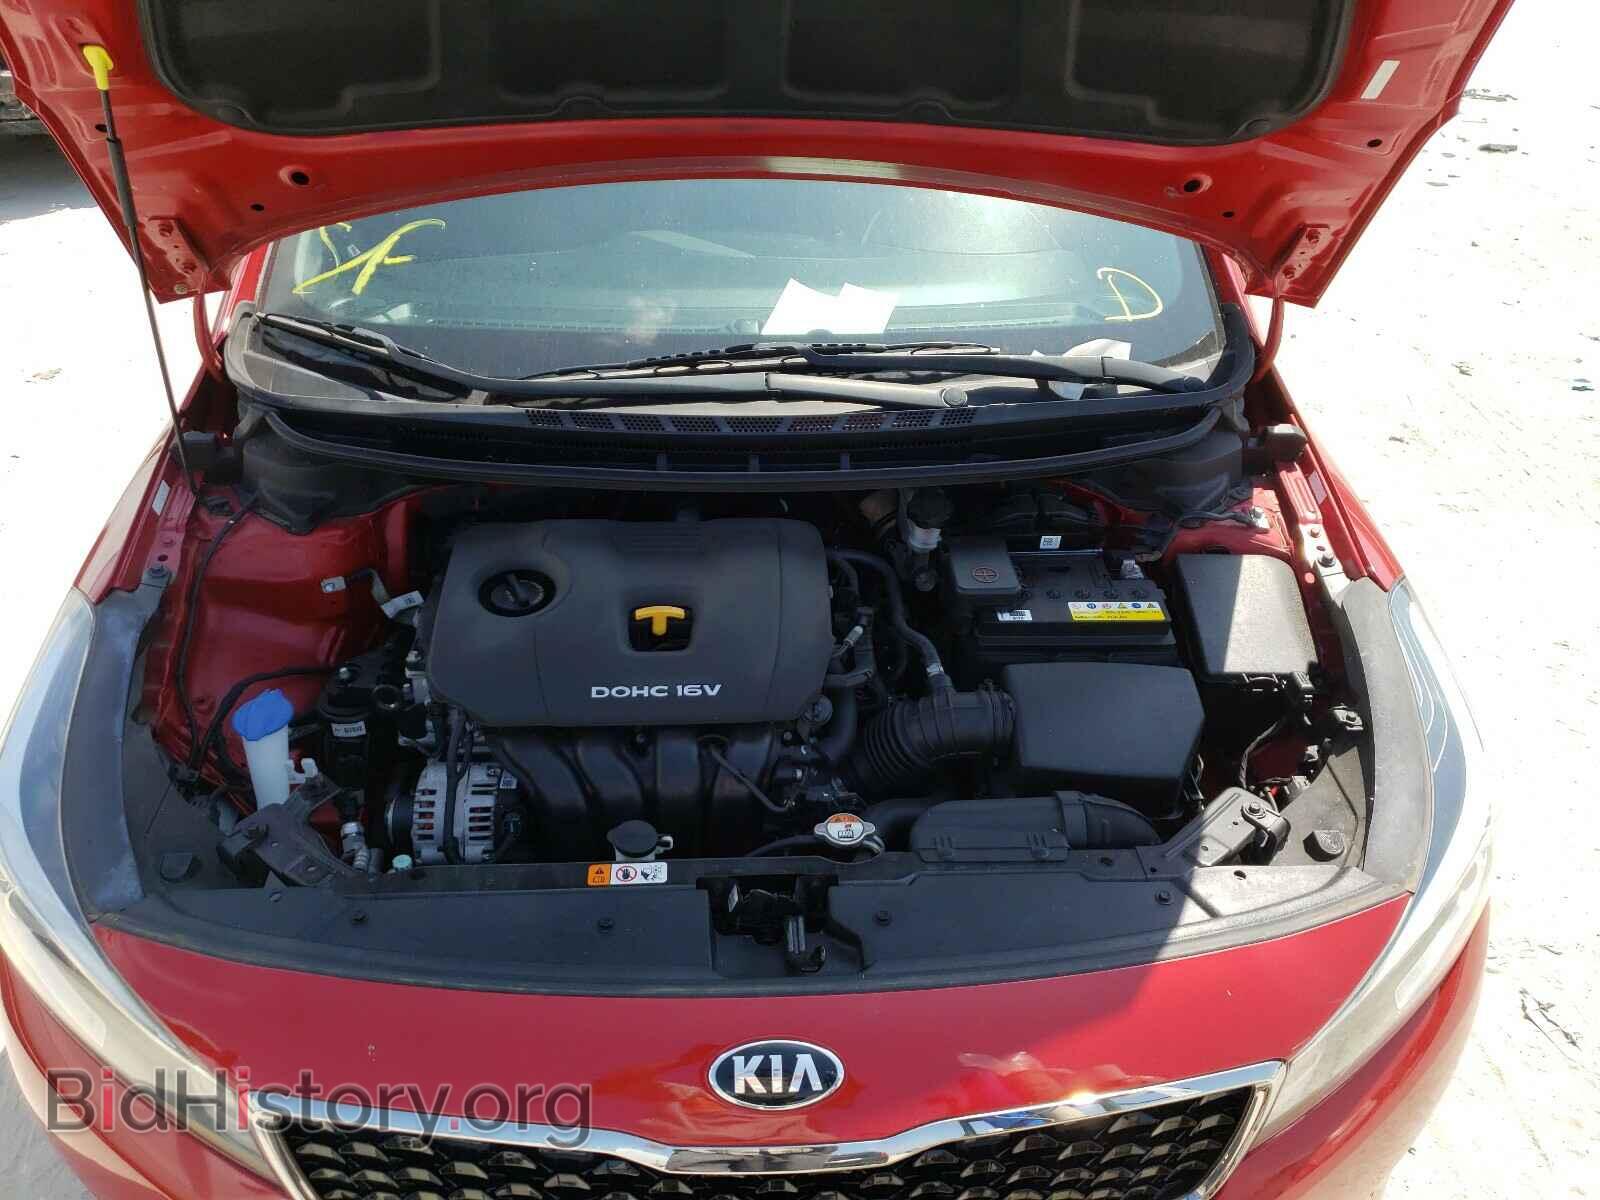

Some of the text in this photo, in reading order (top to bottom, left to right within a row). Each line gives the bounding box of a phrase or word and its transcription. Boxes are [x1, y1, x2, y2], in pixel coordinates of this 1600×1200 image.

[591, 684, 722, 698] DOHC 16V
[732, 1053, 823, 1094] KIA
